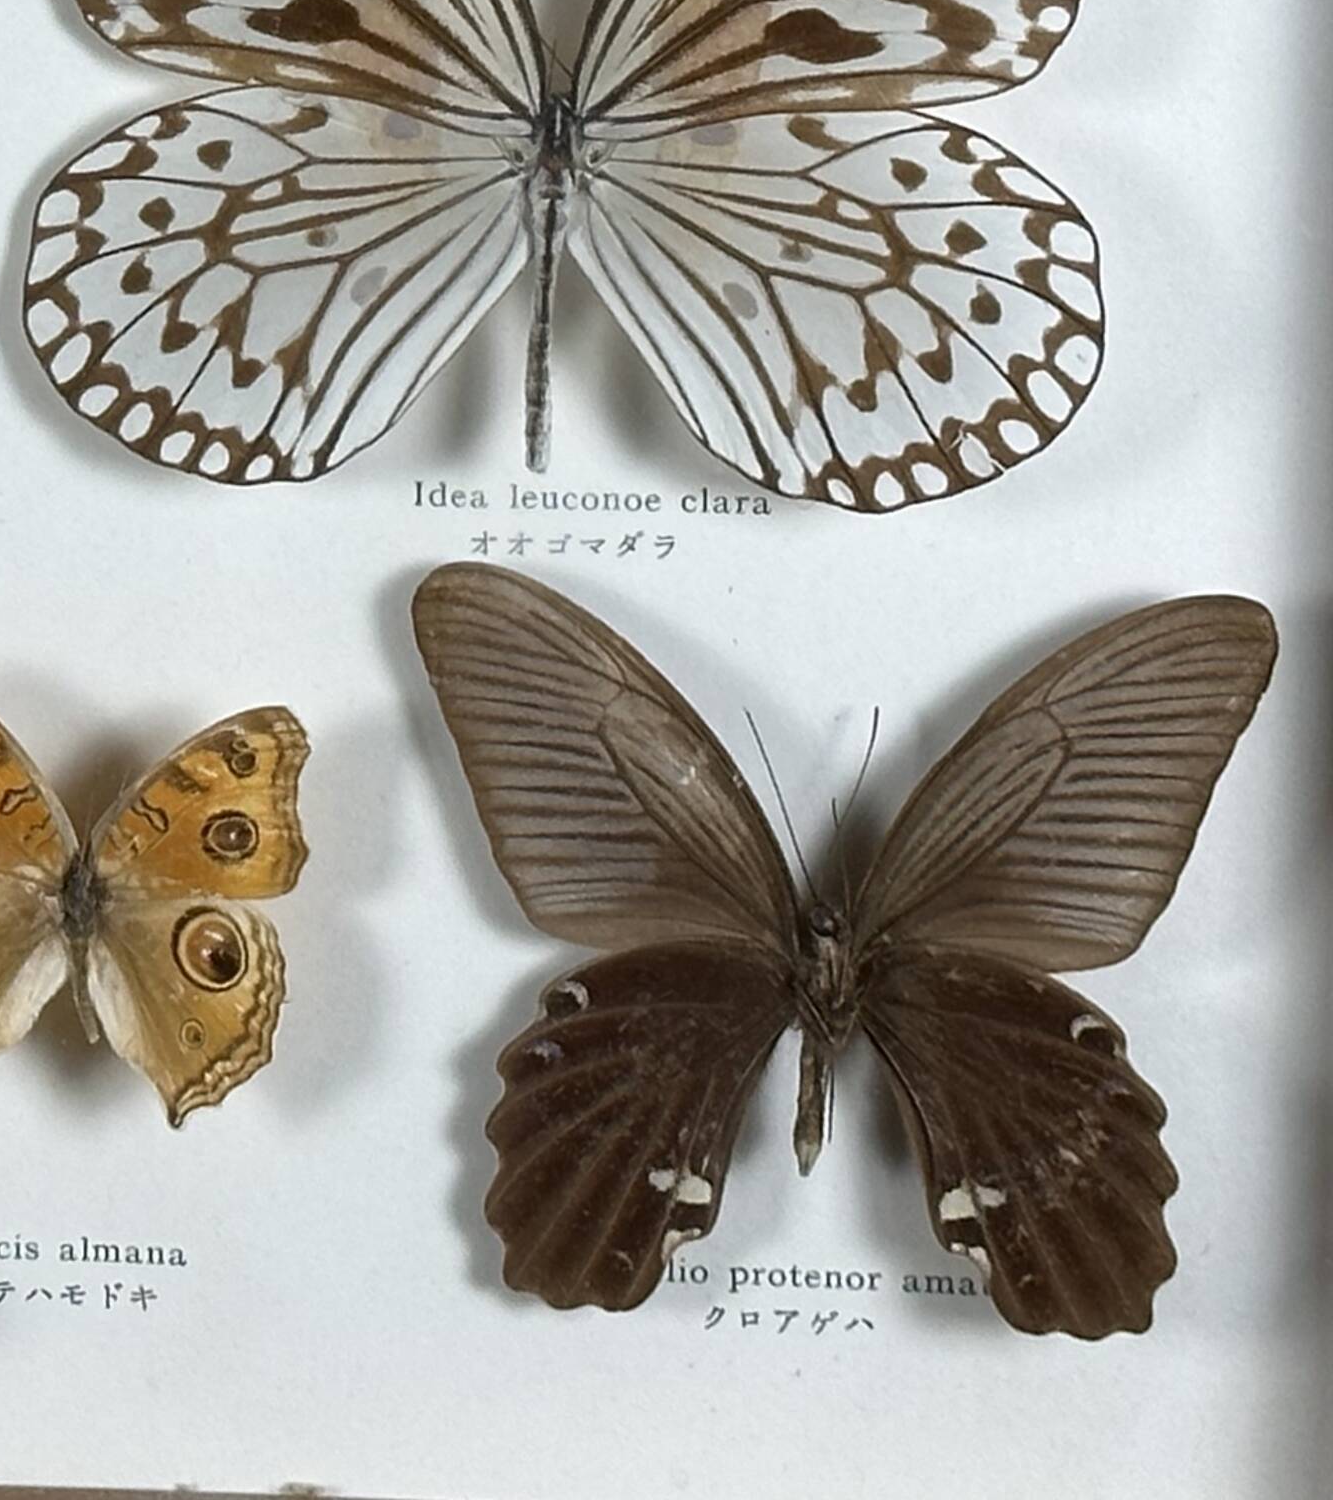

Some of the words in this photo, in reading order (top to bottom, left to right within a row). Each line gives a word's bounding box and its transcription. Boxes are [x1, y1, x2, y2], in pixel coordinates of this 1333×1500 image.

[413, 480, 490, 510] Idea
[509, 482, 662, 513] leuconoe
[676, 486, 773, 516] clara
[470, 529, 676, 560] オオゴマダラ
[58, 1235, 188, 1268] almana
[728, 1263, 883, 1295] protenor
[901, 1274, 988, 1295] ama
[703, 1305, 875, 1337] クロアゲハ
